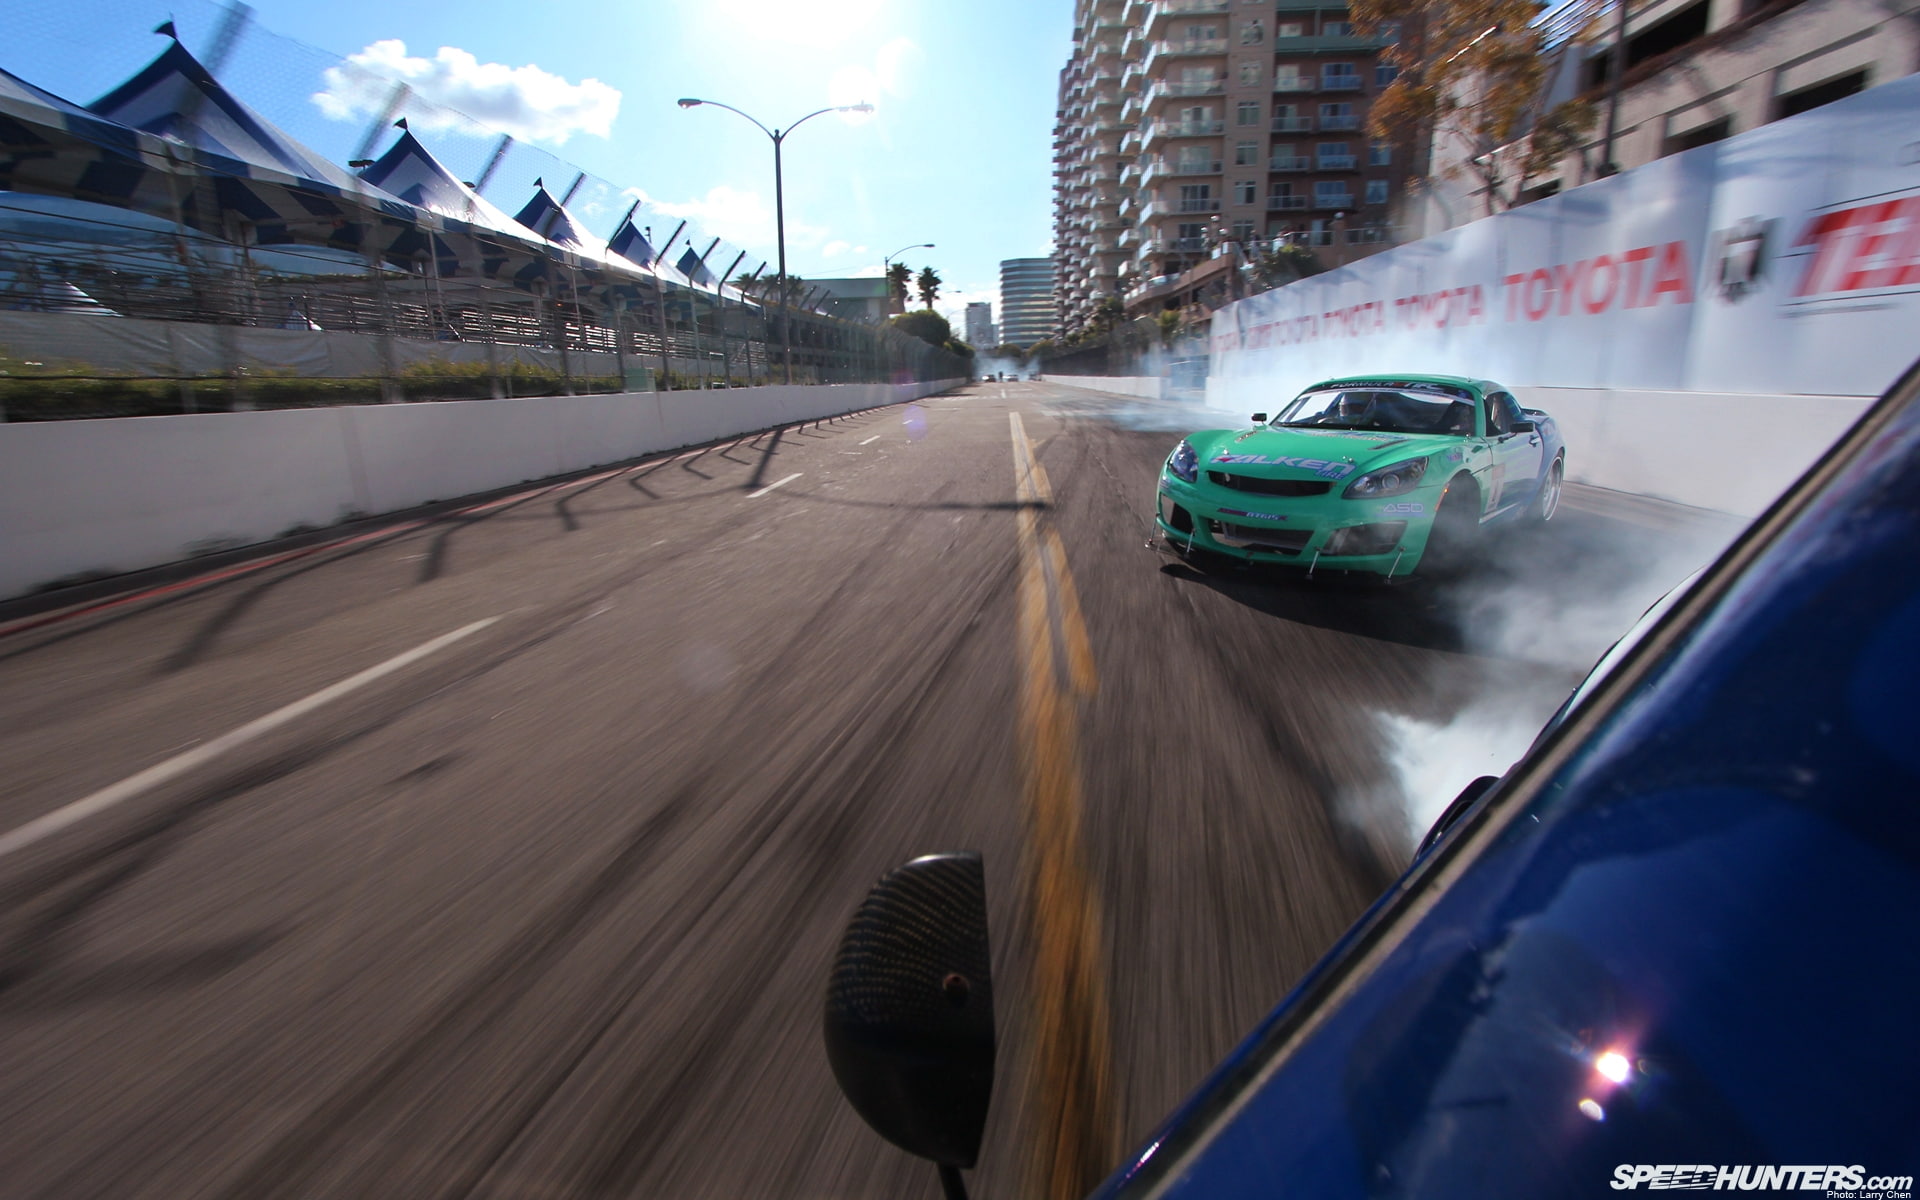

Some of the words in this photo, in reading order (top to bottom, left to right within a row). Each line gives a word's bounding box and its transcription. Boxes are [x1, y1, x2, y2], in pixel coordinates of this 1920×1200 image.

[1394, 284, 1484, 330] TOYOTA
[1503, 240, 1696, 323] TOYOTA
[1210, 454, 1357, 475] FALKEN
[1382, 503, 1425, 513] ASD
